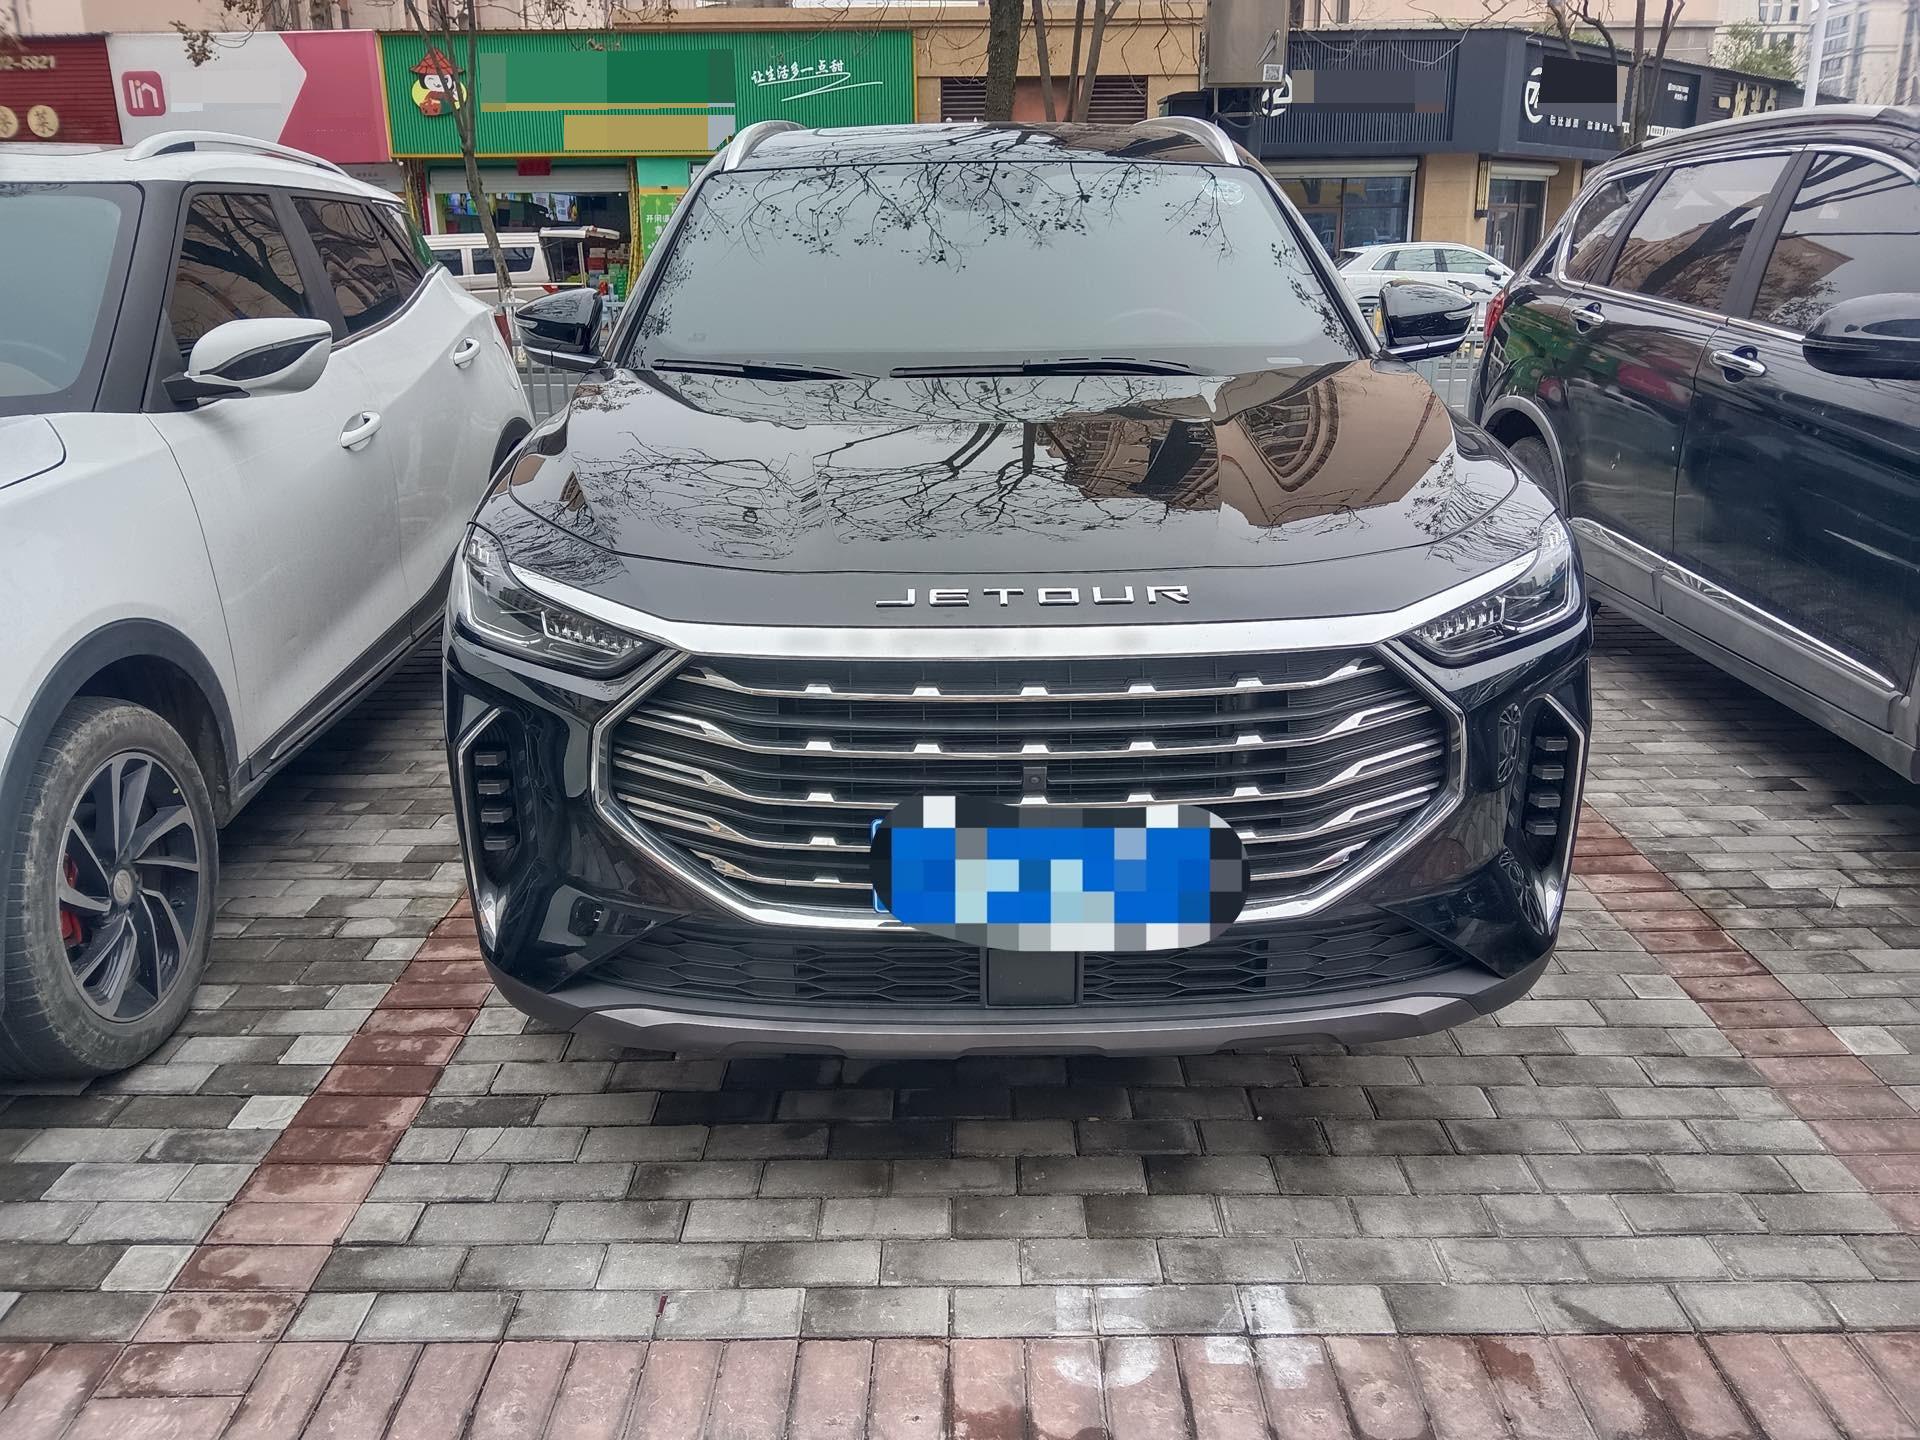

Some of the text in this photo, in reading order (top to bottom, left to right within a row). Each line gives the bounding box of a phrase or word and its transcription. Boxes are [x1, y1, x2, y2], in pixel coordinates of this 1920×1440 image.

[751, 60, 844, 84] 让生活多一点甜
[875, 585, 1190, 607] JETOUR
